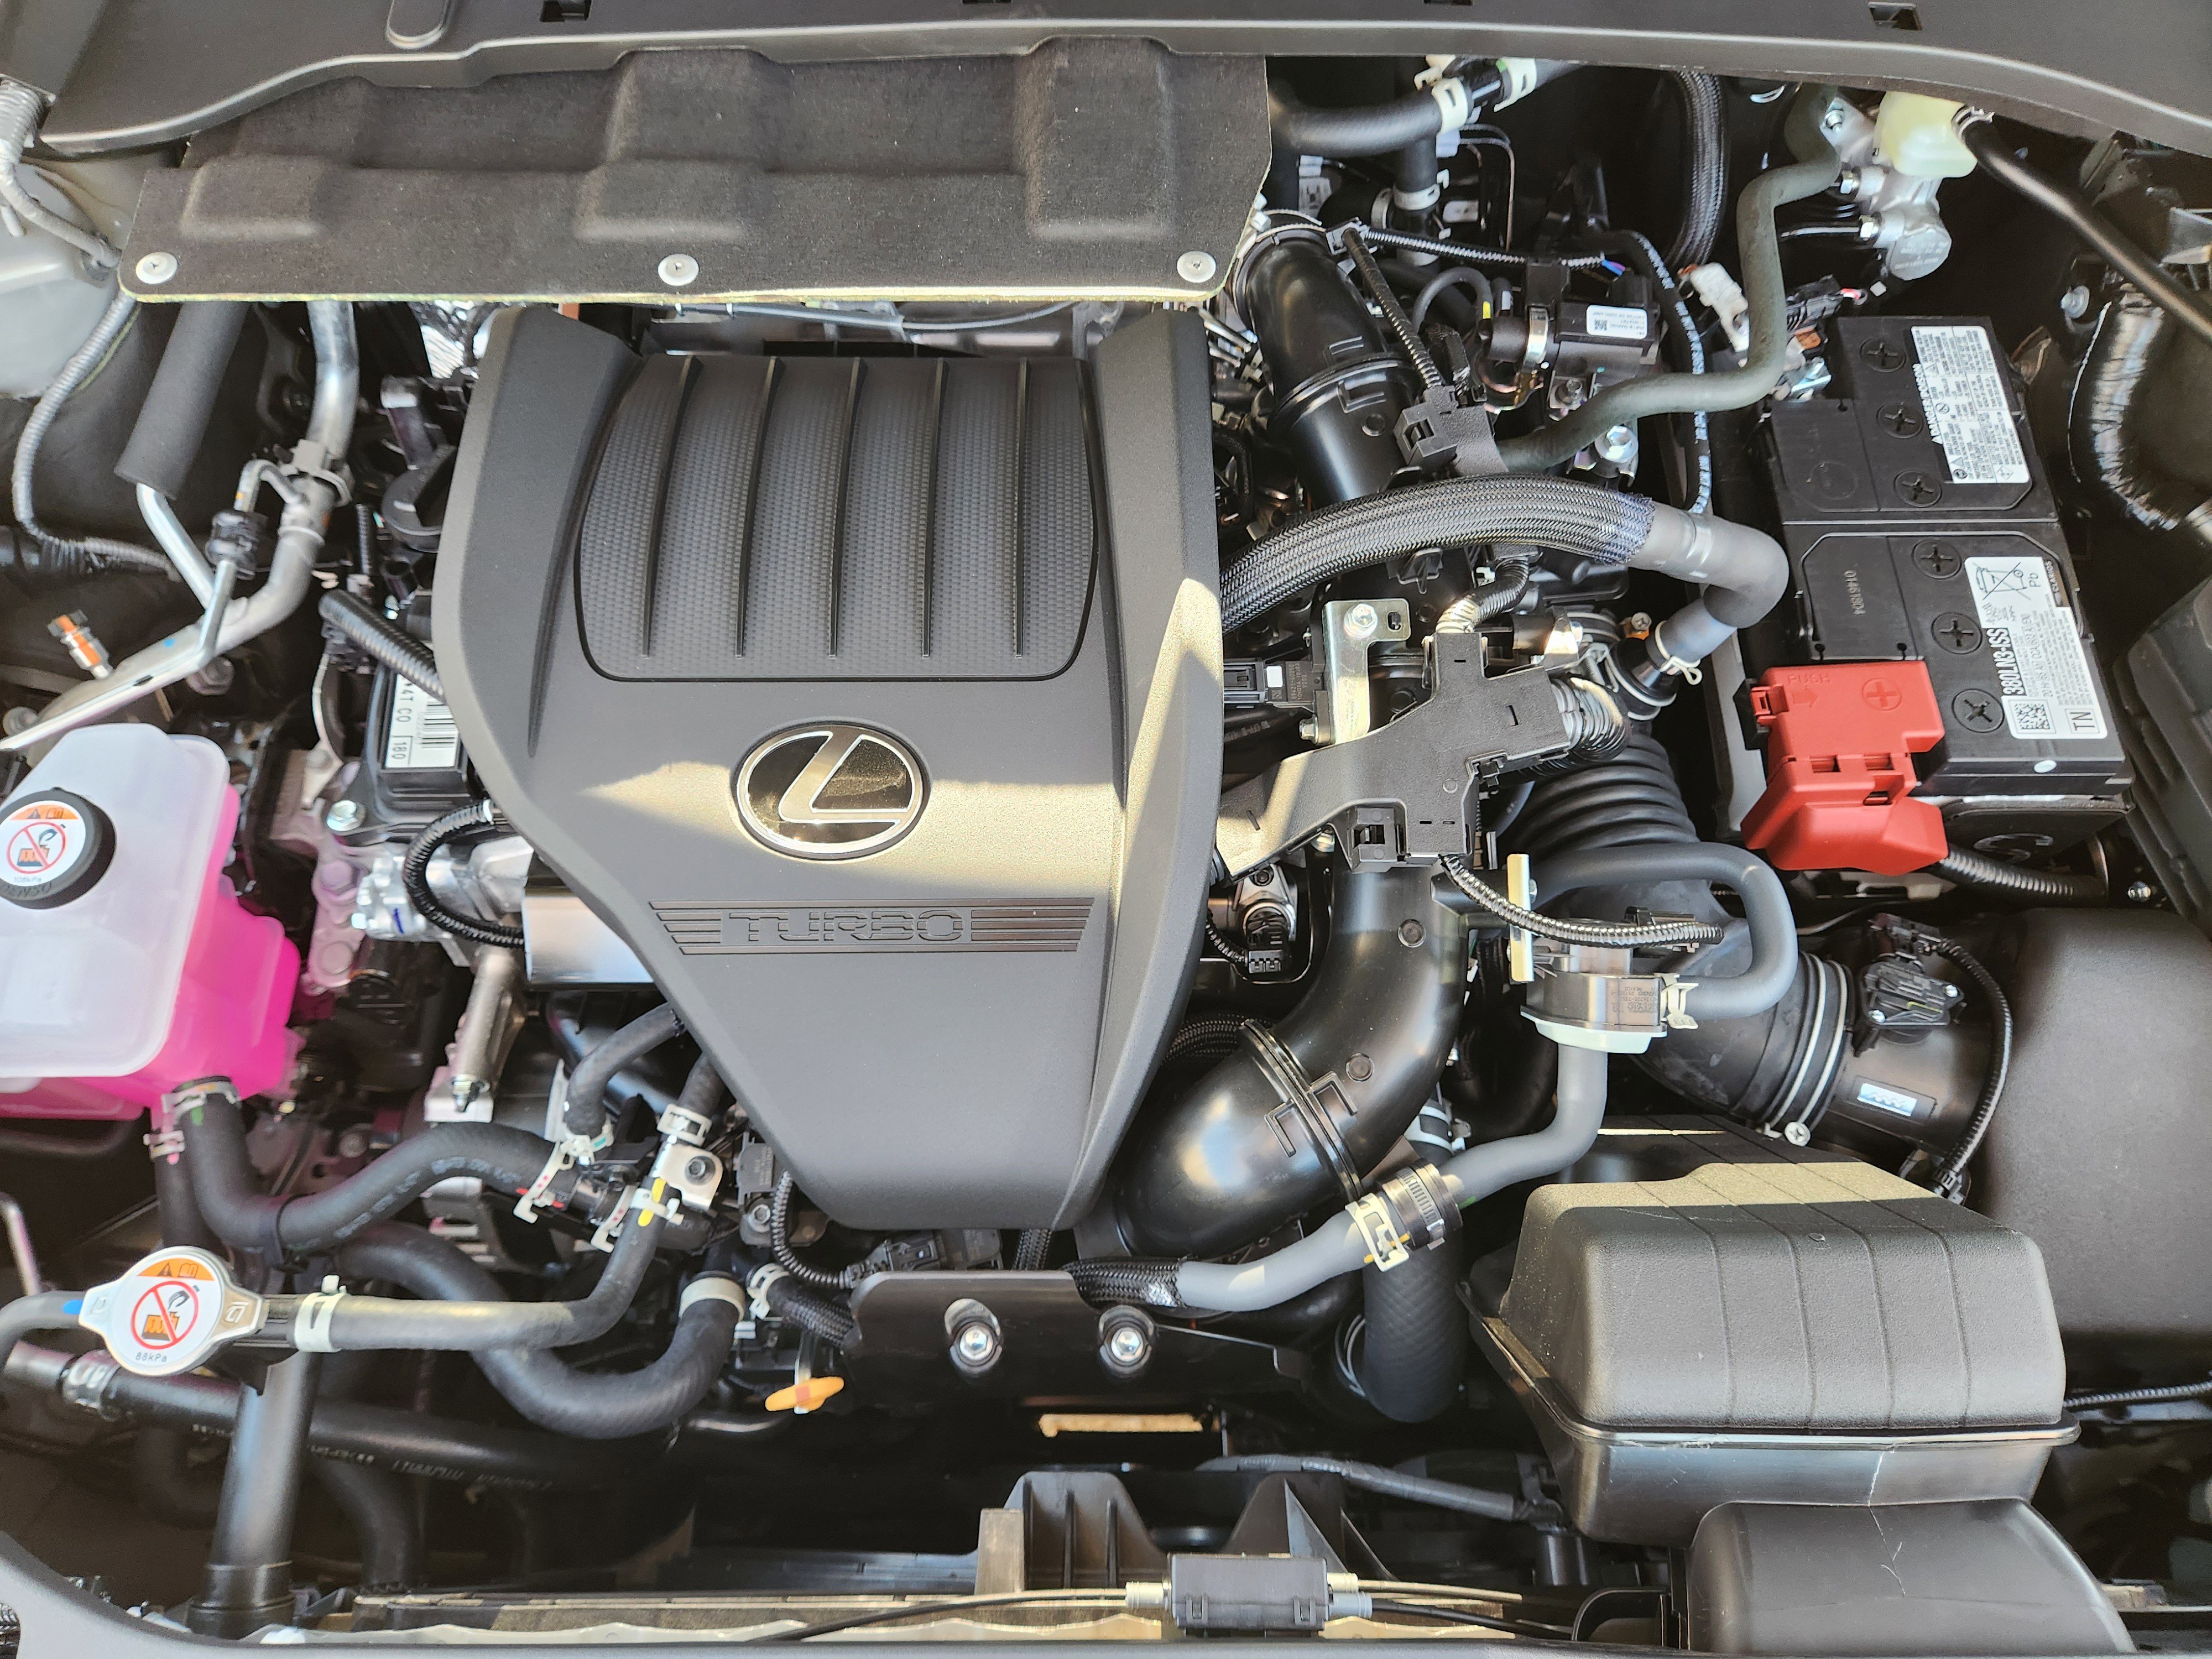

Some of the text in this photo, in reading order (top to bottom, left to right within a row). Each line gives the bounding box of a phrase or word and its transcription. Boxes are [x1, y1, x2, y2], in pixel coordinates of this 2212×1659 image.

[2026, 572, 2041, 587] Pb
[1985, 628, 2025, 695] 380LN3-ISS
[1787, 673, 1830, 685] PUSH
[2070, 712, 2095, 731] TN
[391, 742, 407, 760] 180
[729, 910, 963, 941] TURBO
[135, 1352, 167, 1362] 88kPa
